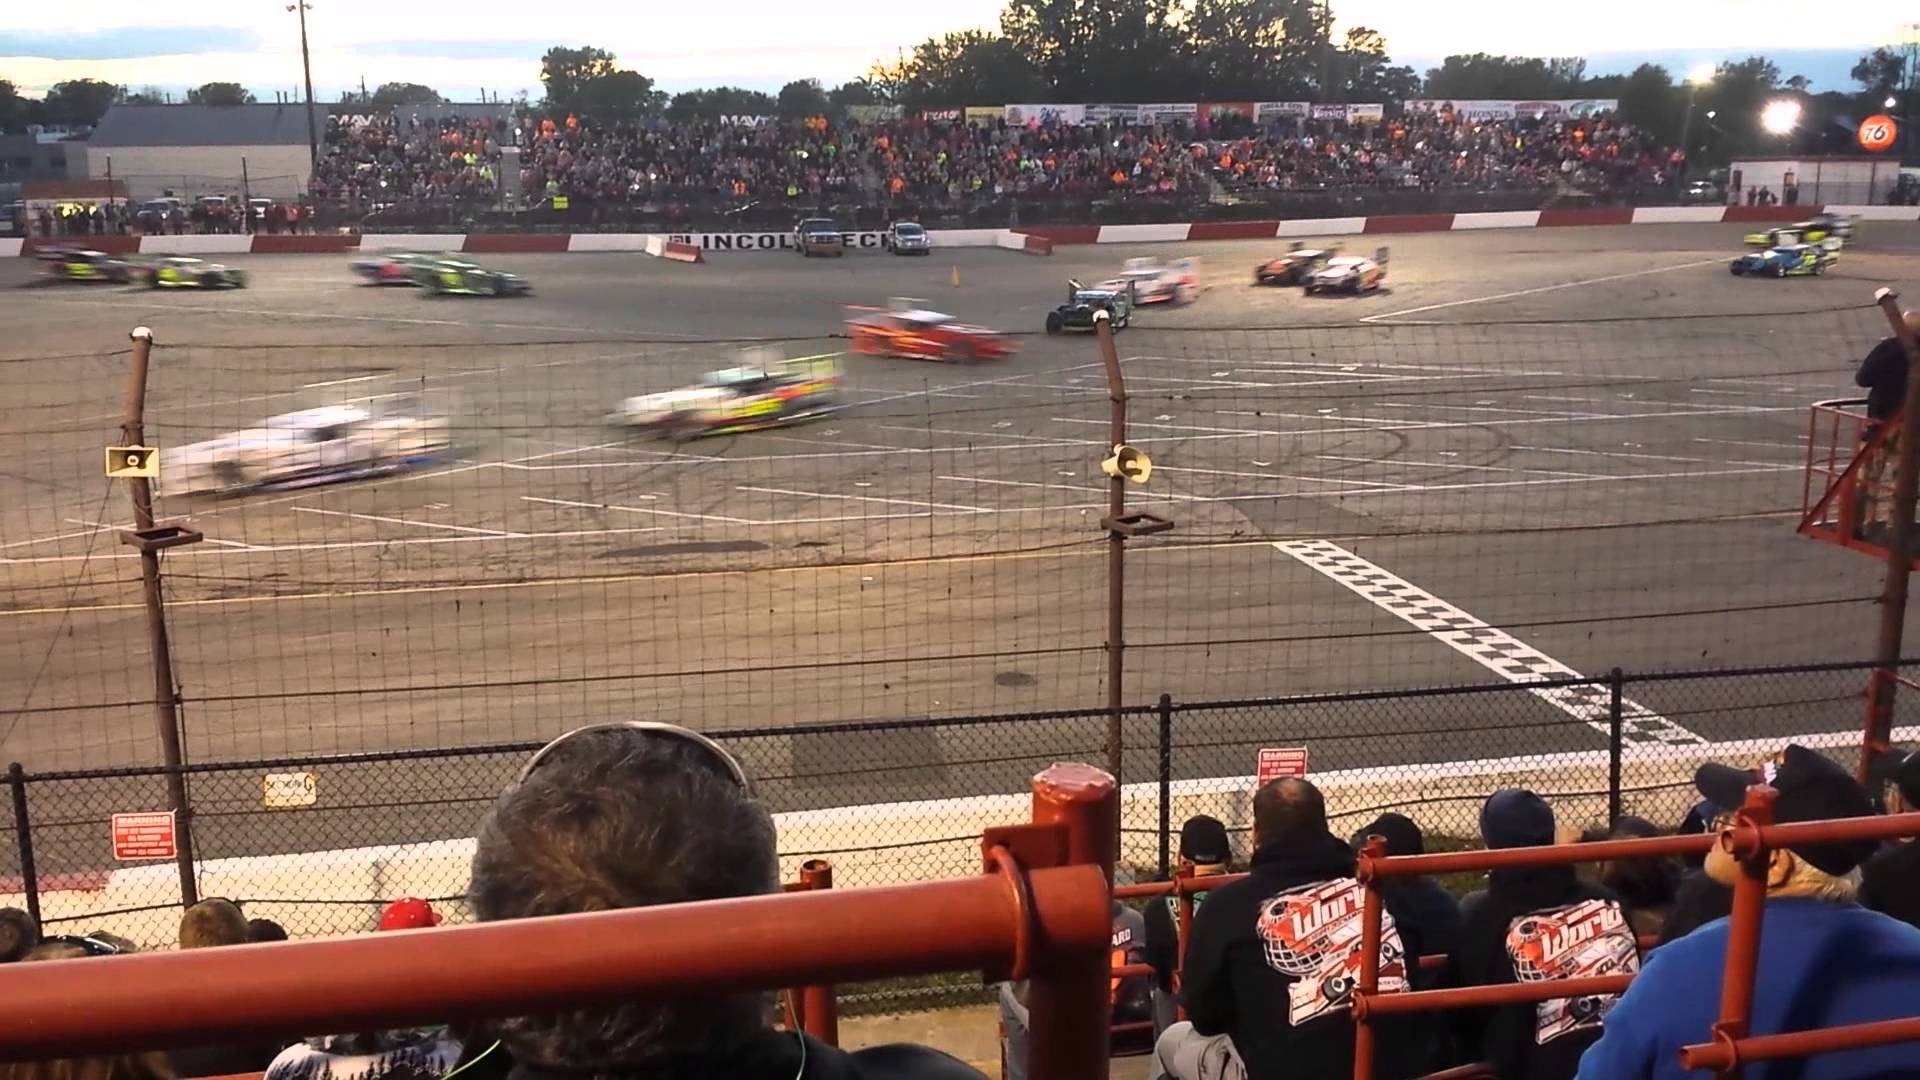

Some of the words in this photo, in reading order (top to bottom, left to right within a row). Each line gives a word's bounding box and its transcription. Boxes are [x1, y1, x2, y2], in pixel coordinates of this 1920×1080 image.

[720, 114, 772, 128] MAVT
[1862, 123, 1887, 142] 76
[685, 234, 794, 249] INCOL
[841, 233, 888, 247] EC
[1291, 886, 1366, 941] Worl
[1111, 928, 1132, 946] ARD
